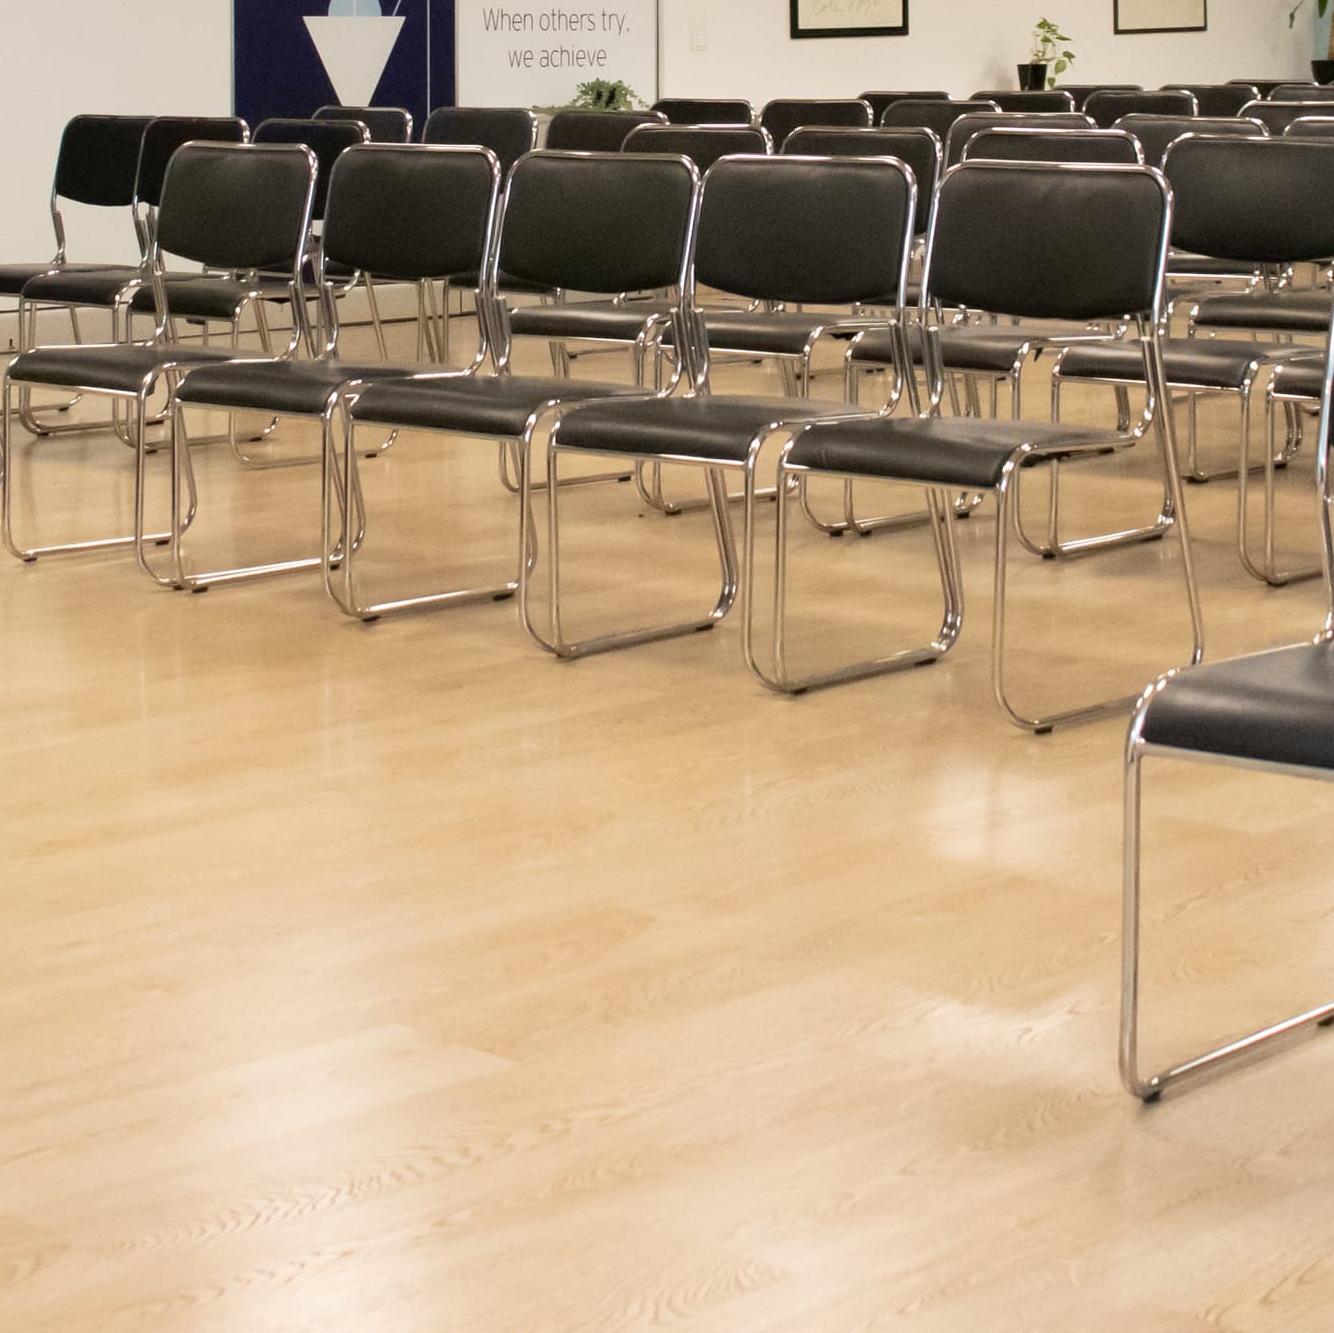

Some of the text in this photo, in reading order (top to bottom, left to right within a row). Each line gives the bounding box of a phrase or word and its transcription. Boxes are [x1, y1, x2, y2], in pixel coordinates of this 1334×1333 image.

[482, 7, 534, 32] When
[539, 8, 596, 32] others
[508, 44, 607, 68] we achieve
